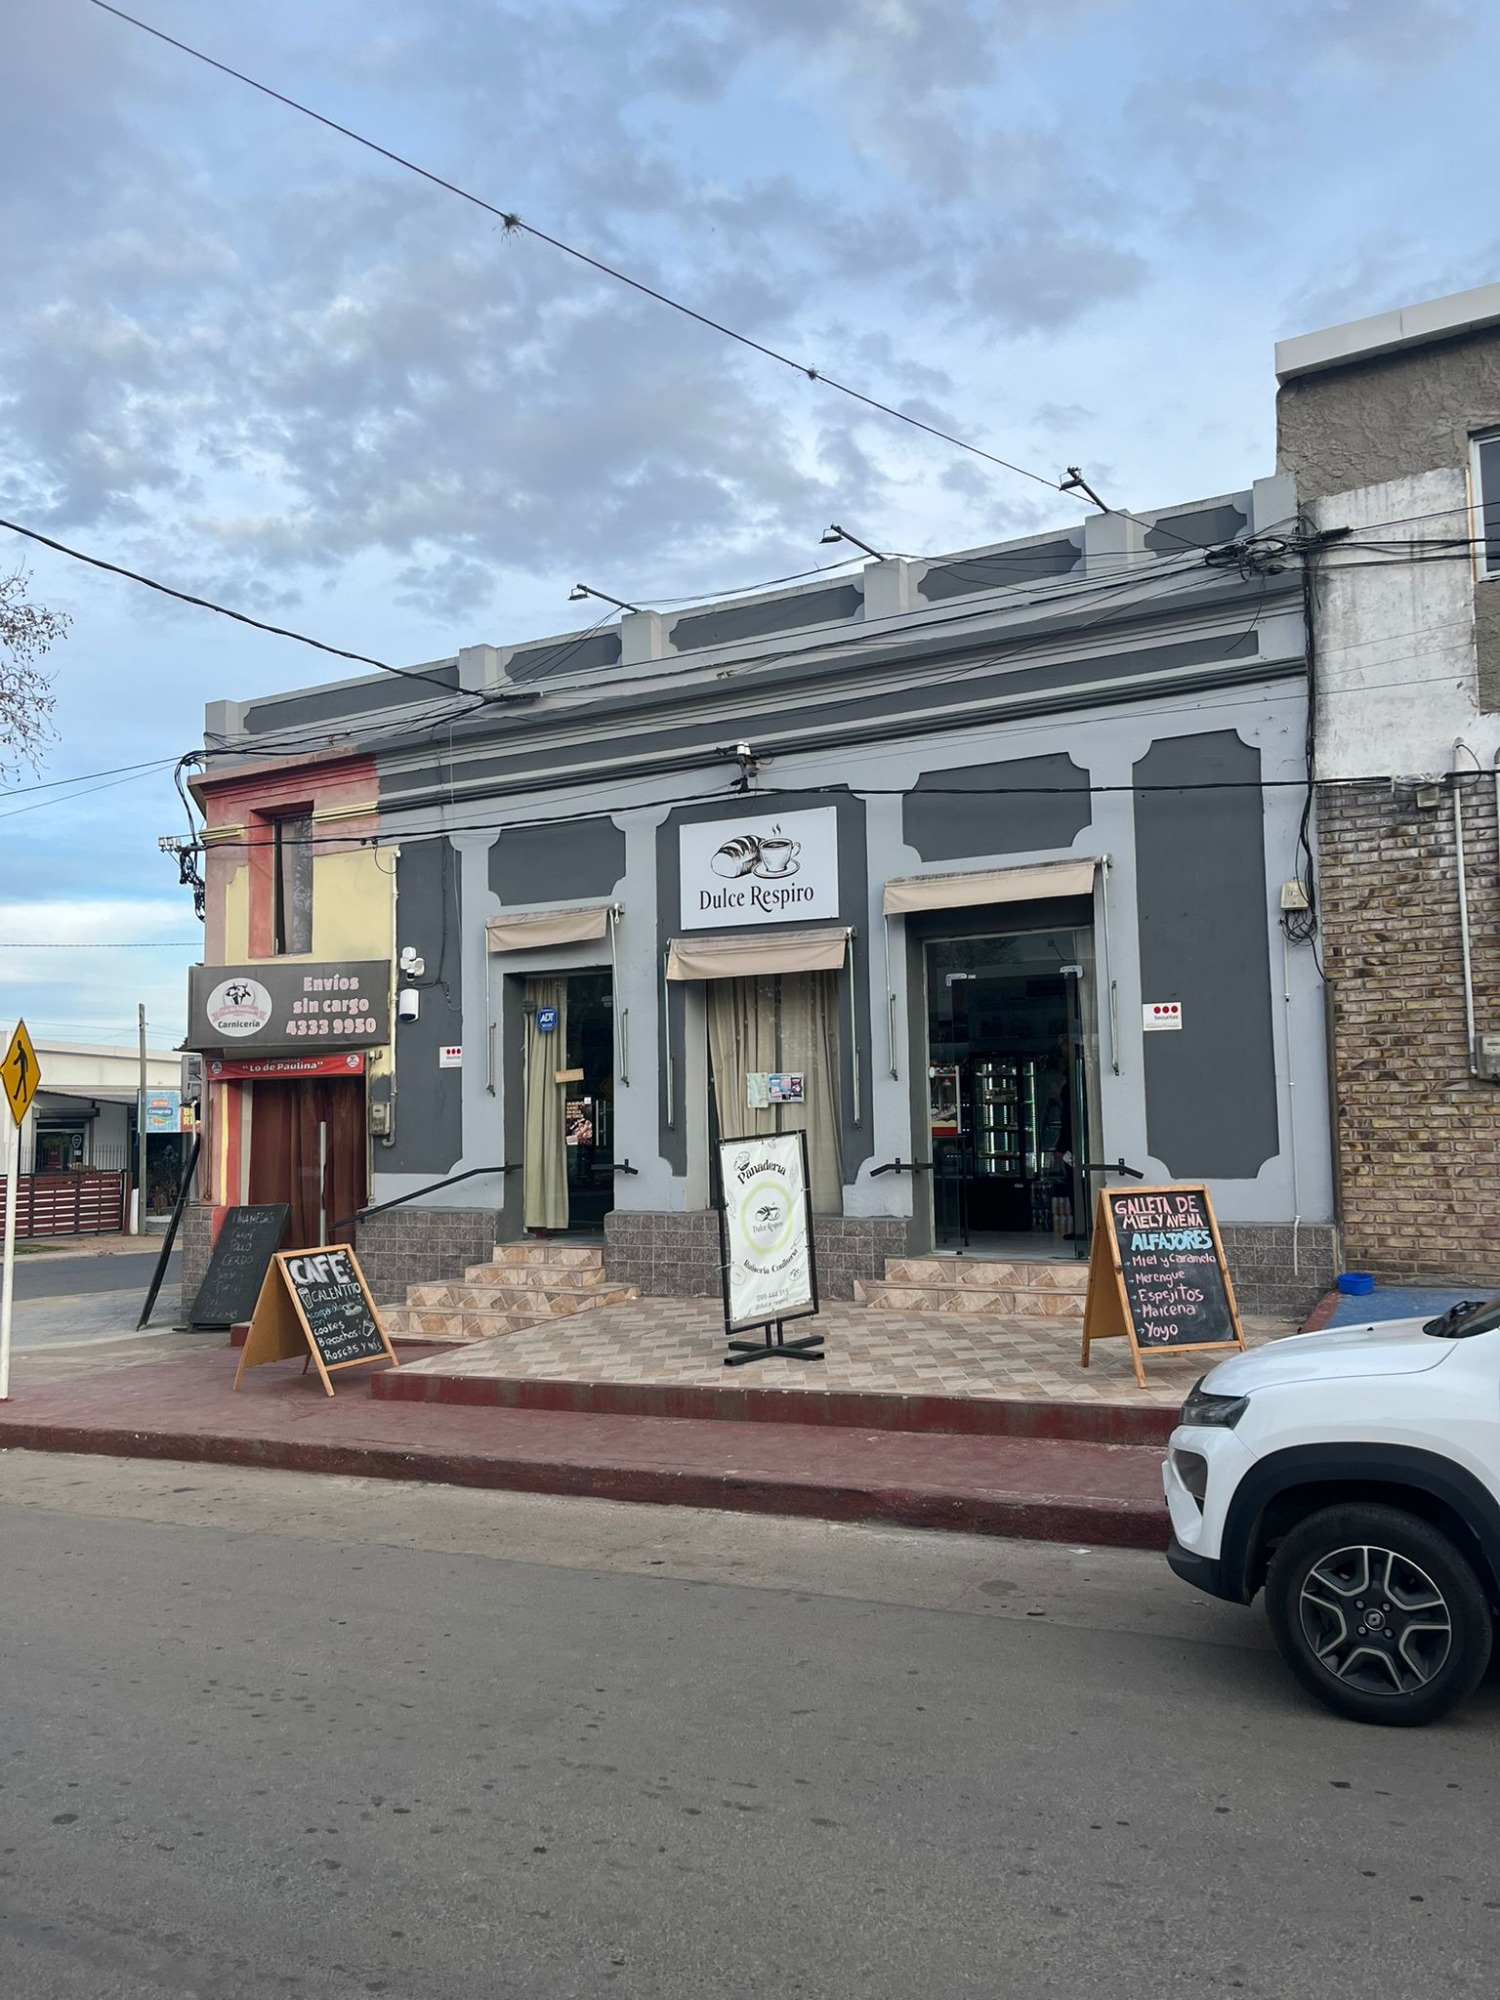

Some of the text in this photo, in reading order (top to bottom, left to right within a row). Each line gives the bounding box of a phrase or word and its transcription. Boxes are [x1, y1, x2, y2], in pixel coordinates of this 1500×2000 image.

[699, 882, 814, 913] Dulce Respiro
[303, 973, 360, 992] Envíos
[292, 997, 370, 1015] sin cargo
[217, 1019, 261, 1029] Carnicería
[286, 1017, 377, 1035] 4333 9950
[540, 1012, 555, 1023] ADT
[263, 1063, 276, 1071] de
[1114, 1195, 1200, 1215] GALLETA DE
[1166, 1213, 1204, 1228] AVENA
[1131, 1229, 1214, 1251] ALFAJORES
[1132, 1254, 1158, 1267] Miel
[1135, 1270, 1186, 1288] Merengue
[311, 1282, 362, 1303] CALENTITO
[1138, 1283, 1205, 1305] Espejitos
[1142, 1303, 1197, 1318] Maicena
[1144, 1321, 1179, 1341] Yoyo
